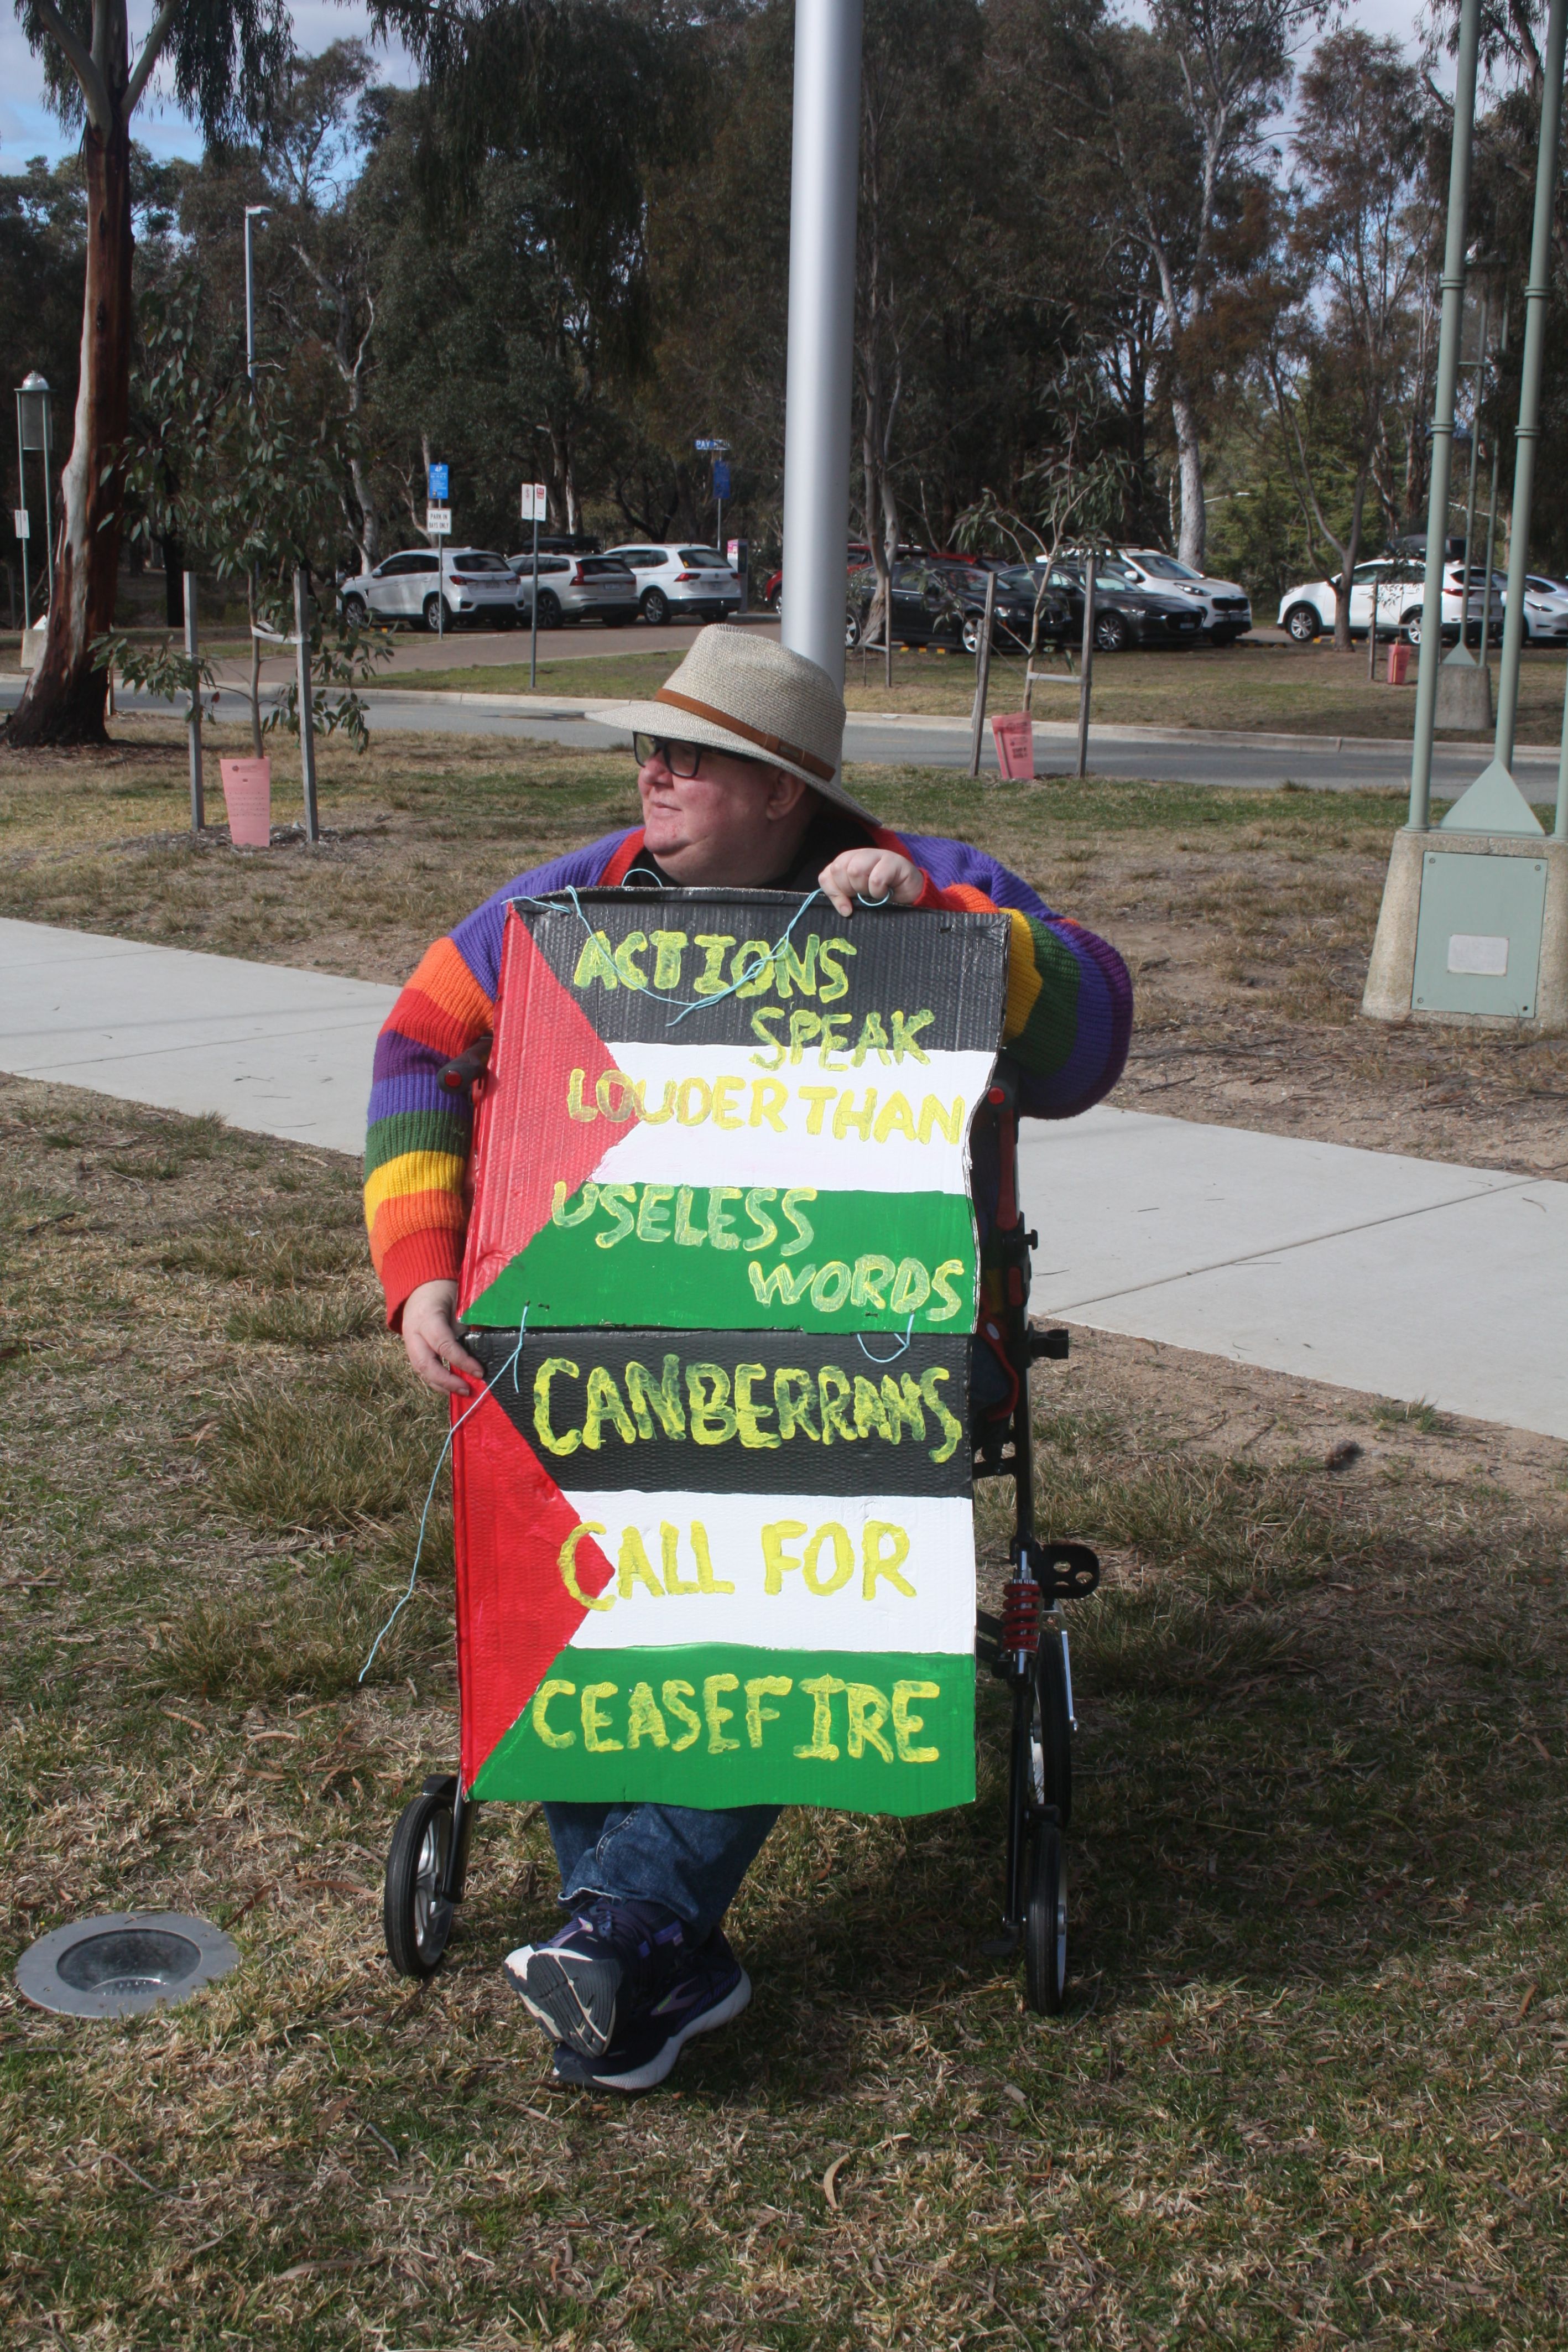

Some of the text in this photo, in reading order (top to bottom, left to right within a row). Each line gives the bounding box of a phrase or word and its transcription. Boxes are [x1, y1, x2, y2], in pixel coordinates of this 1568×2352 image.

[574, 929, 857, 1003] ACTIONS
[749, 1006, 935, 1071] SPEAK
[567, 1068, 966, 1144] LOUDER THAN
[552, 1181, 817, 1257] USELESS
[749, 1254, 965, 1321] WORDS
[533, 1354, 962, 1463] CANBERRANS
[558, 1520, 917, 1611] CALL FOR
[532, 1673, 940, 1763] CEASEFIRE
